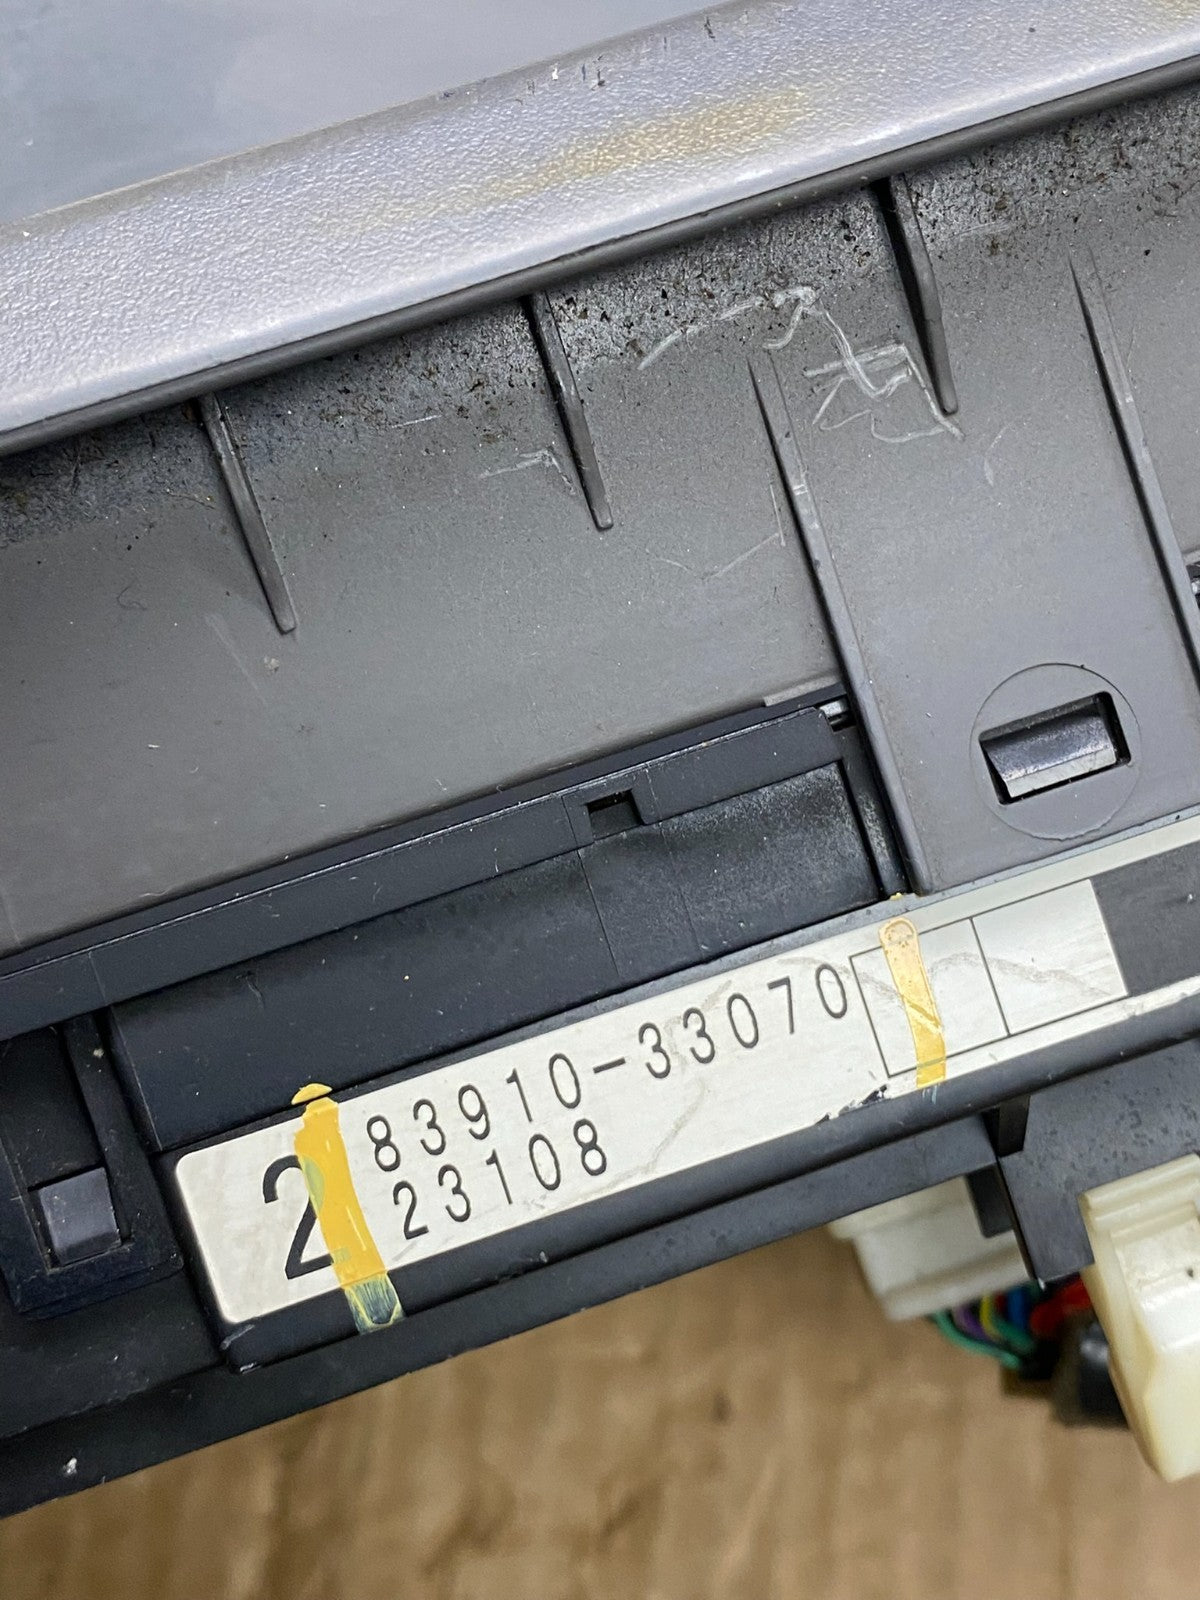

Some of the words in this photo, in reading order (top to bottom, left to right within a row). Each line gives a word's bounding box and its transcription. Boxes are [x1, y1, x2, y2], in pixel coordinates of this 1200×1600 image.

[367, 963, 848, 1173] 83910-33070
[262, 1154, 344, 1281] 2
[393, 1118, 607, 1241] 23108
